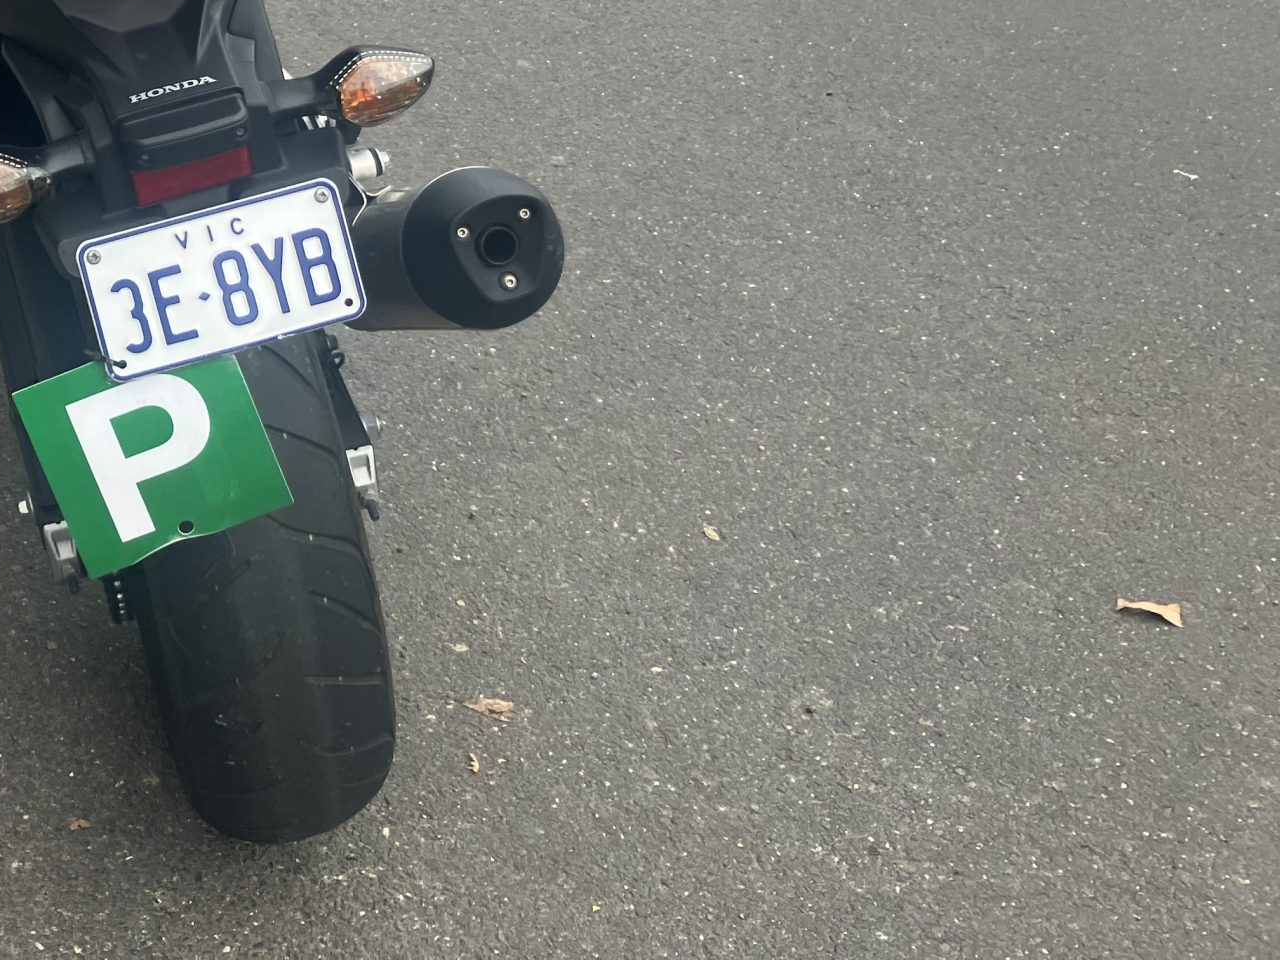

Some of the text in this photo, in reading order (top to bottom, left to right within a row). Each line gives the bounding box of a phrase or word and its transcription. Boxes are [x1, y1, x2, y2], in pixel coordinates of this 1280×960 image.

[129, 76, 217, 103] HONDA
[174, 217, 245, 249] VIC
[65, 373, 210, 542] P
